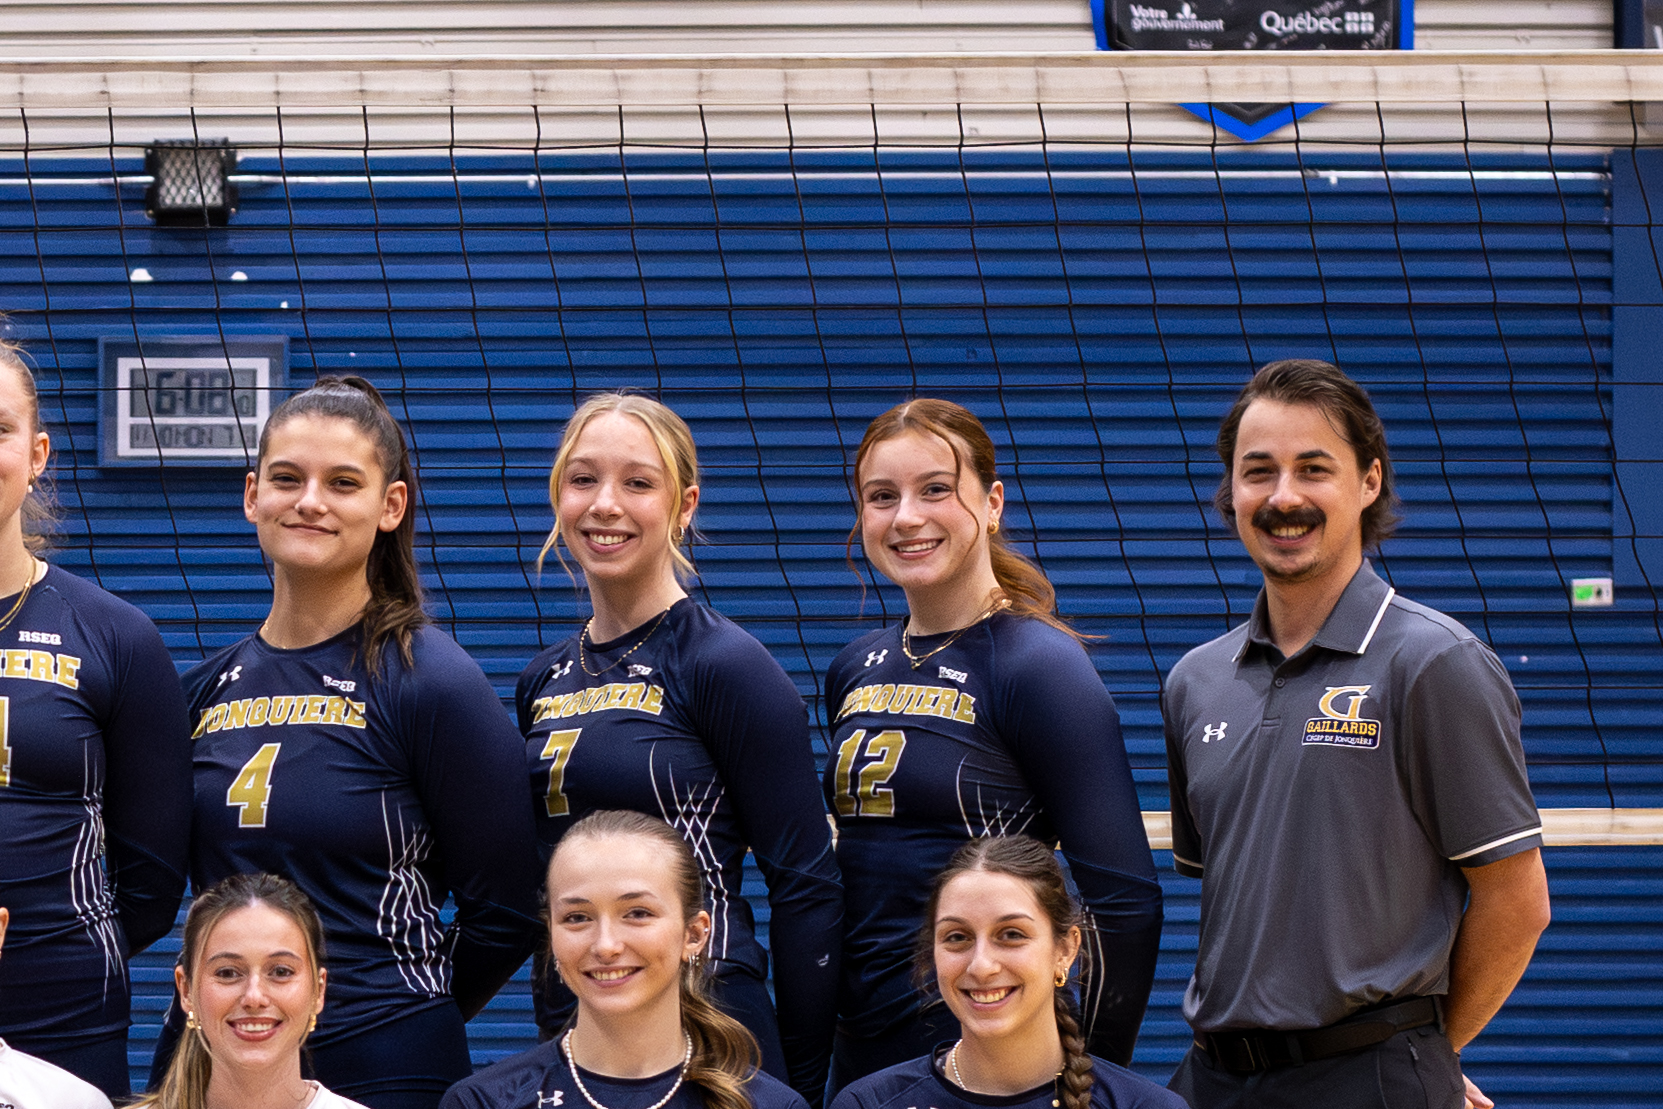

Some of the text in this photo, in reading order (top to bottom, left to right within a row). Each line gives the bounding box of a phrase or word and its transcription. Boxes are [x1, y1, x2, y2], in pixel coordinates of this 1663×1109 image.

[1129, 4, 1168, 18] Votre
[1131, 18, 1224, 32] gouvernement
[1260, 10, 1343, 36] Québec
[18, 631, 62, 645] RSEQ
[938, 666, 967, 684] RSEQ
[1306, 720, 1377, 736] GAILLARDS
[539, 728, 584, 817] 7
[835, 729, 906, 818] 12
[227, 743, 281, 828] 4
